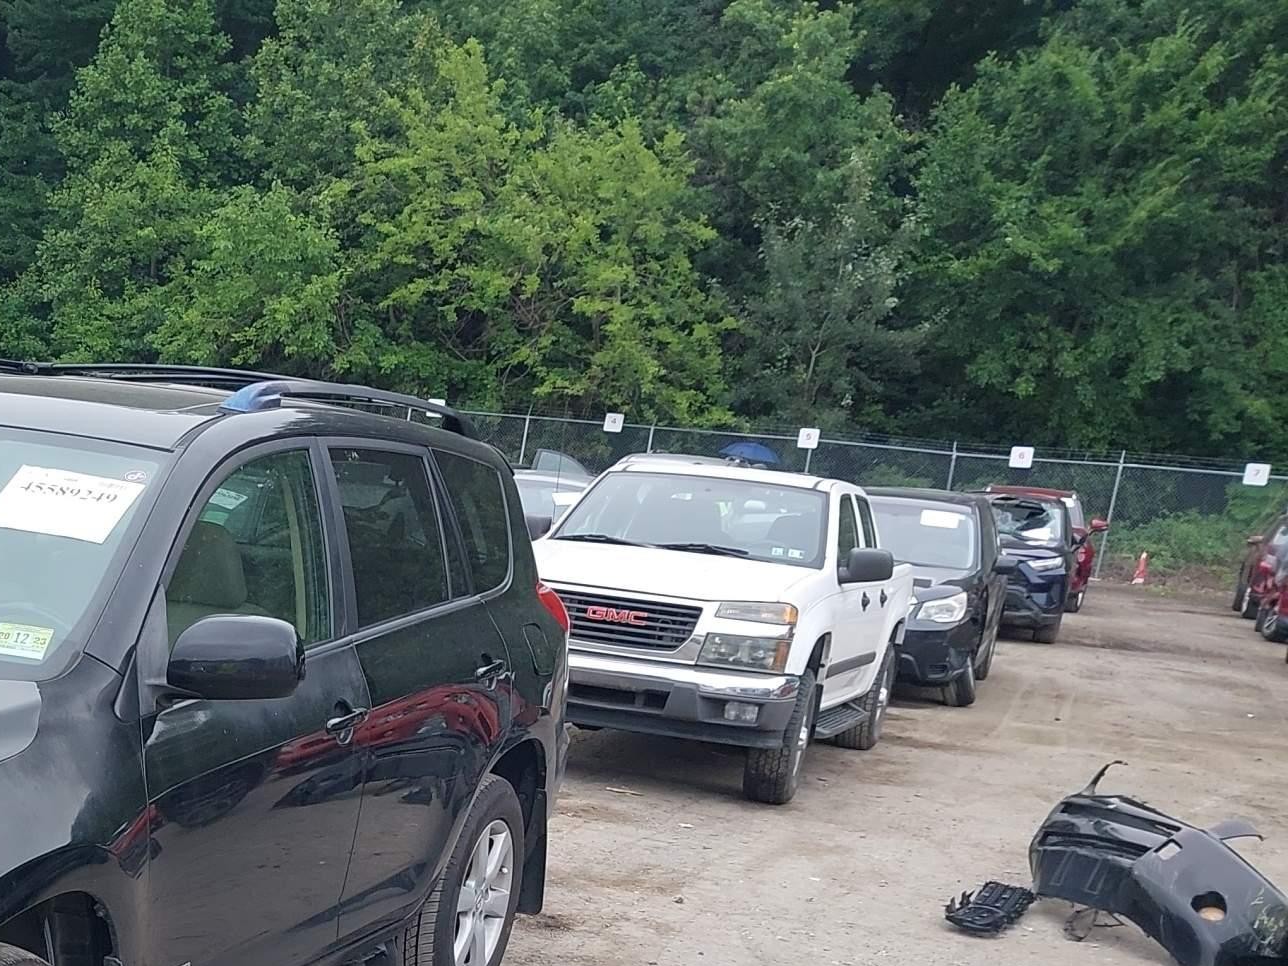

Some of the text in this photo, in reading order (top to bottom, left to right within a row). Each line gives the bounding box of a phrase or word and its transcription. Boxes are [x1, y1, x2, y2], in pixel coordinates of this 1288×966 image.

[20, 481, 118, 503] 45589249
[587, 605, 649, 626] GMC
[13, 632, 30, 645] 12
